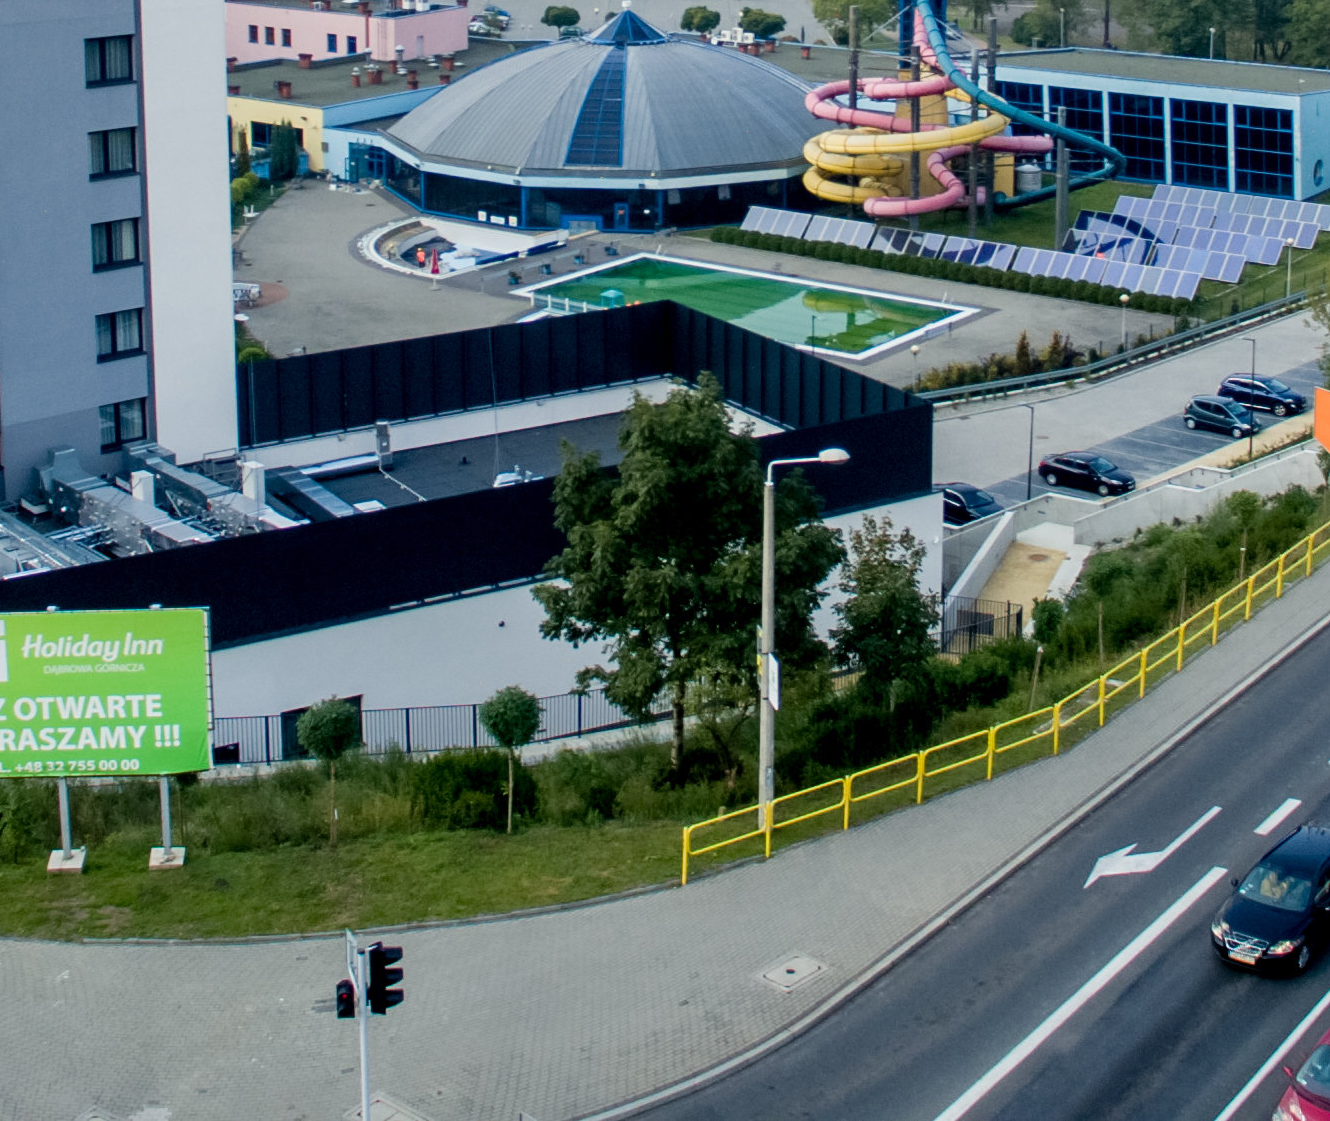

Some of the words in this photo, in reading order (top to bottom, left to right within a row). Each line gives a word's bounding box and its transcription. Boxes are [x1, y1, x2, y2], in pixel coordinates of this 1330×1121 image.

[21, 633, 120, 662] Holiday
[123, 632, 163, 656] Inn
[13, 694, 163, 722] OTWARTE
[154, 724, 181, 748] !!!
[15, 760, 42, 773] +48
[46, 760, 64, 772] 32
[68, 759, 96, 772] 755
[99, 759, 118, 771] 00
[120, 758, 140, 771] 00
